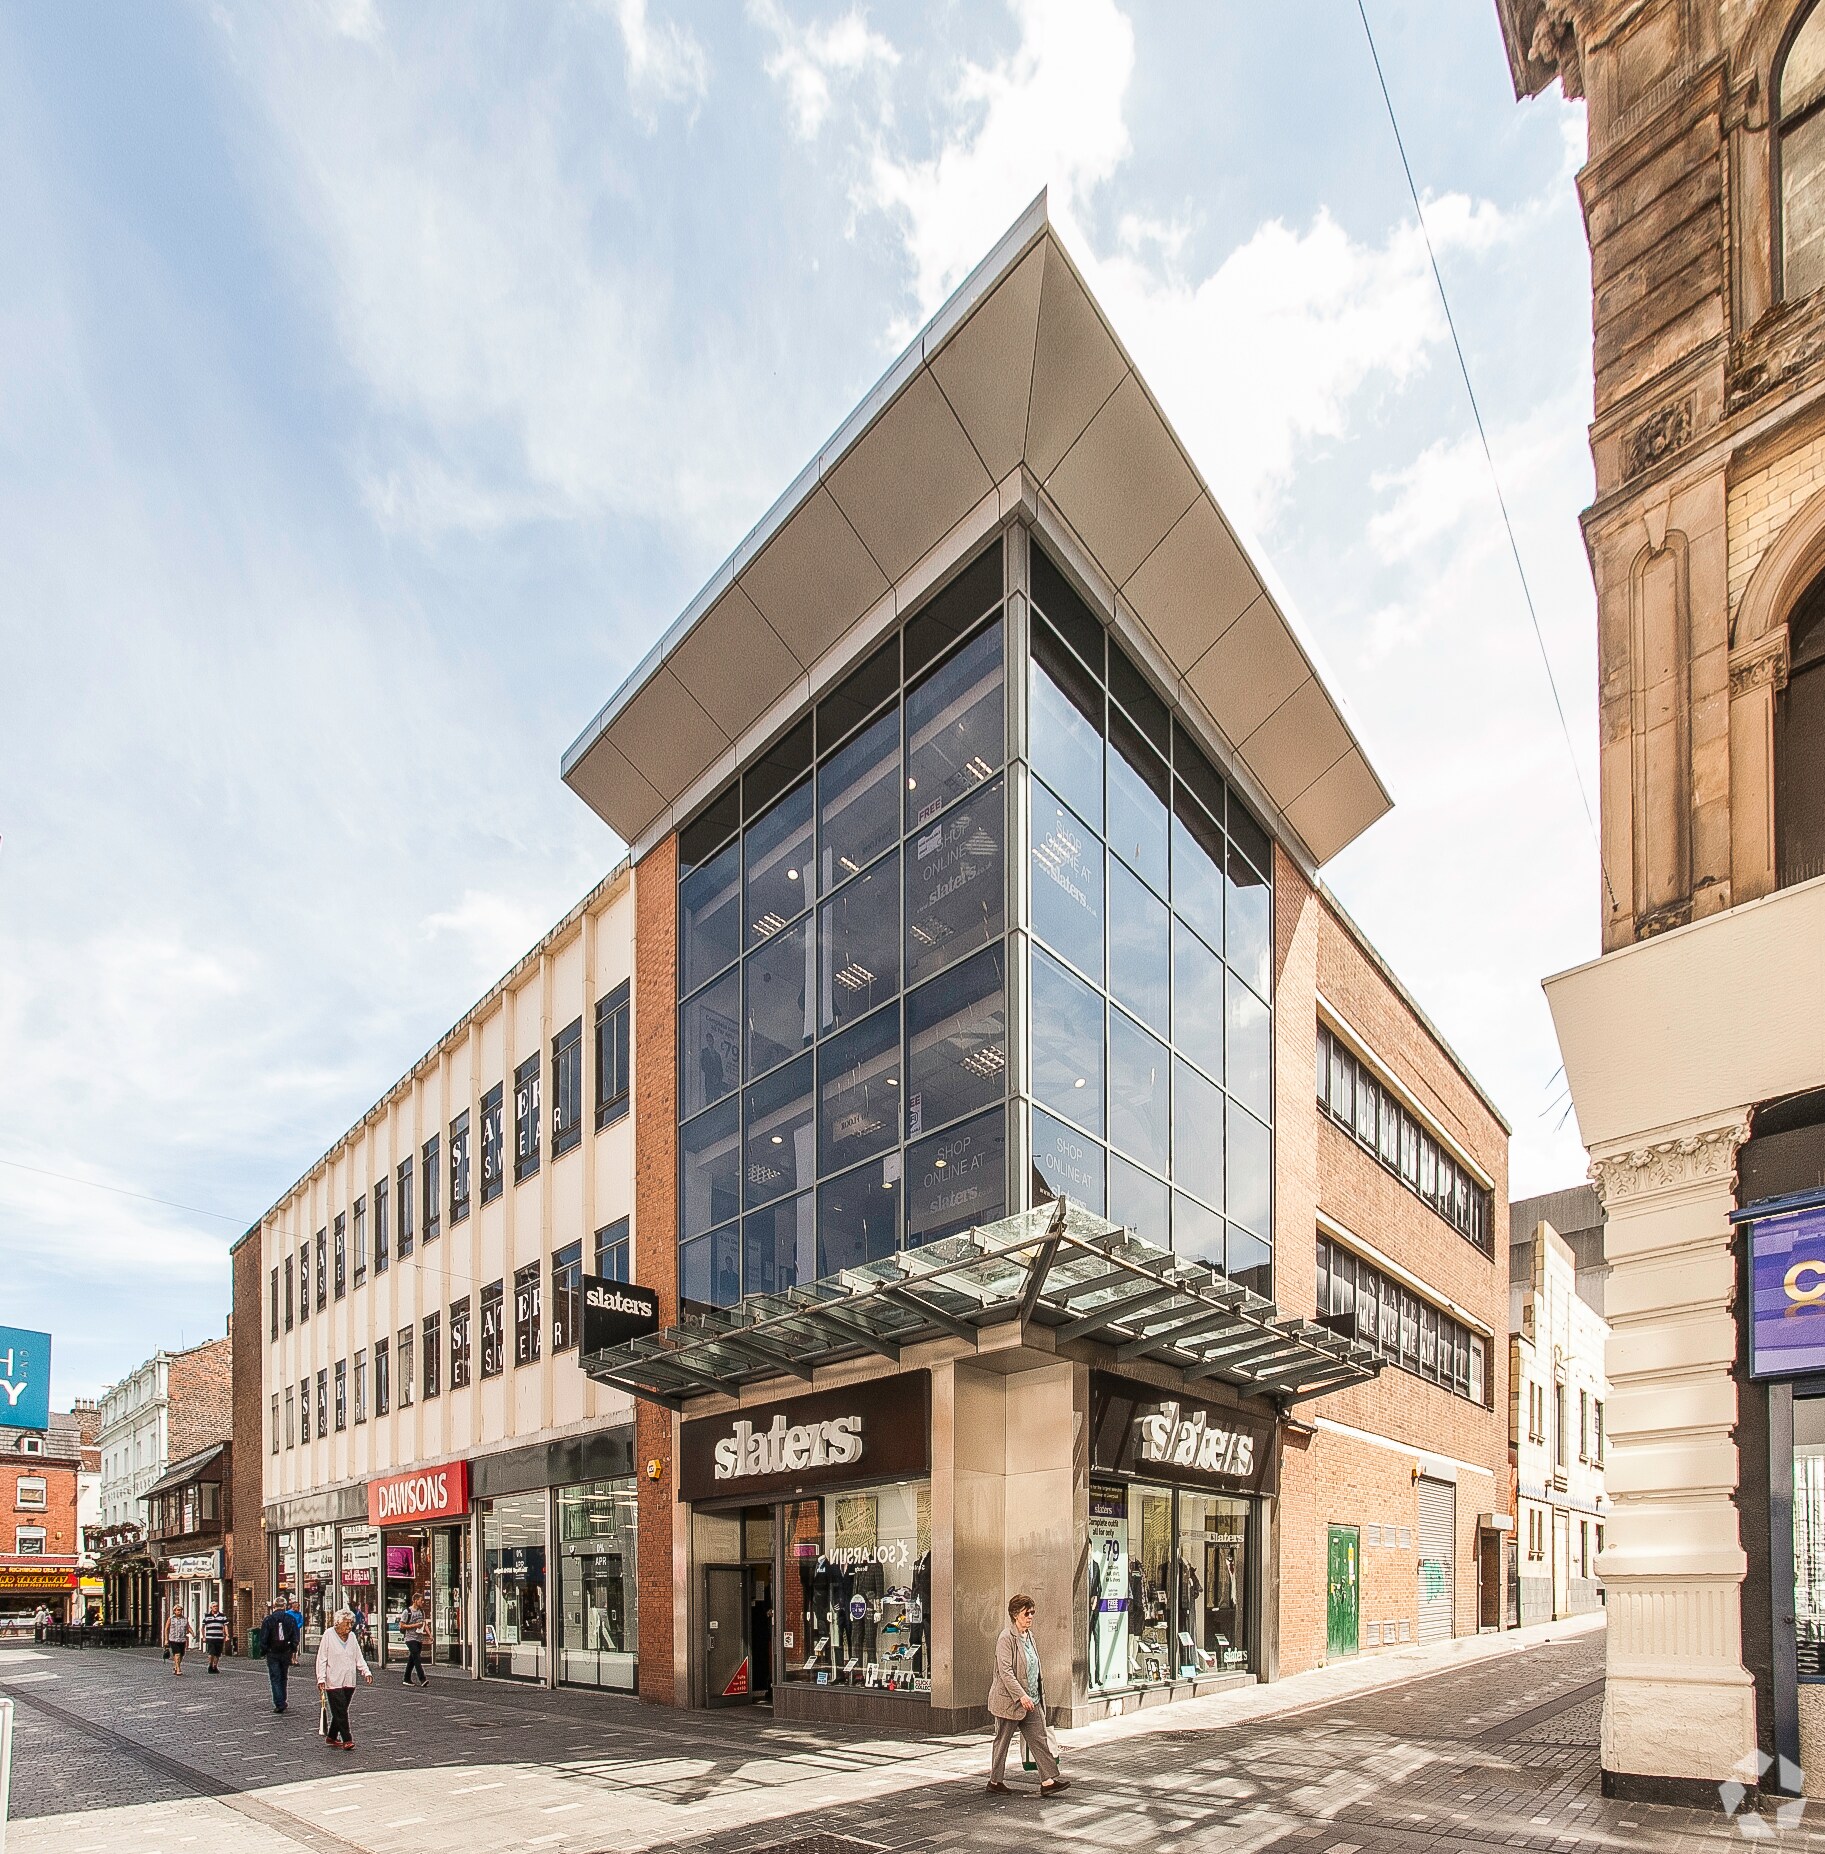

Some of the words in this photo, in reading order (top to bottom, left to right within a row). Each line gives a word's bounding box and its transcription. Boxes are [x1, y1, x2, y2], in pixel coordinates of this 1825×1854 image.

[919, 799, 941, 822] FREE
[937, 1137, 970, 1160] SHOP
[1056, 1137, 1083, 1161] SHOP
[923, 1159, 967, 1193] ONLINE
[971, 1152, 985, 1171] AT
[1046, 1153, 1080, 1183] ONLINE
[1082, 1173, 1092, 1188] AT
[586, 1286, 652, 1317] slaters
[715, 1415, 862, 1479] slaters
[1142, 1401, 1253, 1476] slaters
[378, 1472, 447, 1518] DAWSONS
[1094, 1504, 1113, 1514] slaters
[595, 1556, 607, 1566] APR
[1103, 1540, 1120, 1561] £79
[17, 1575, 69, 1584] TAKEAWAY
[1224, 1647, 1247, 1663] slaters
